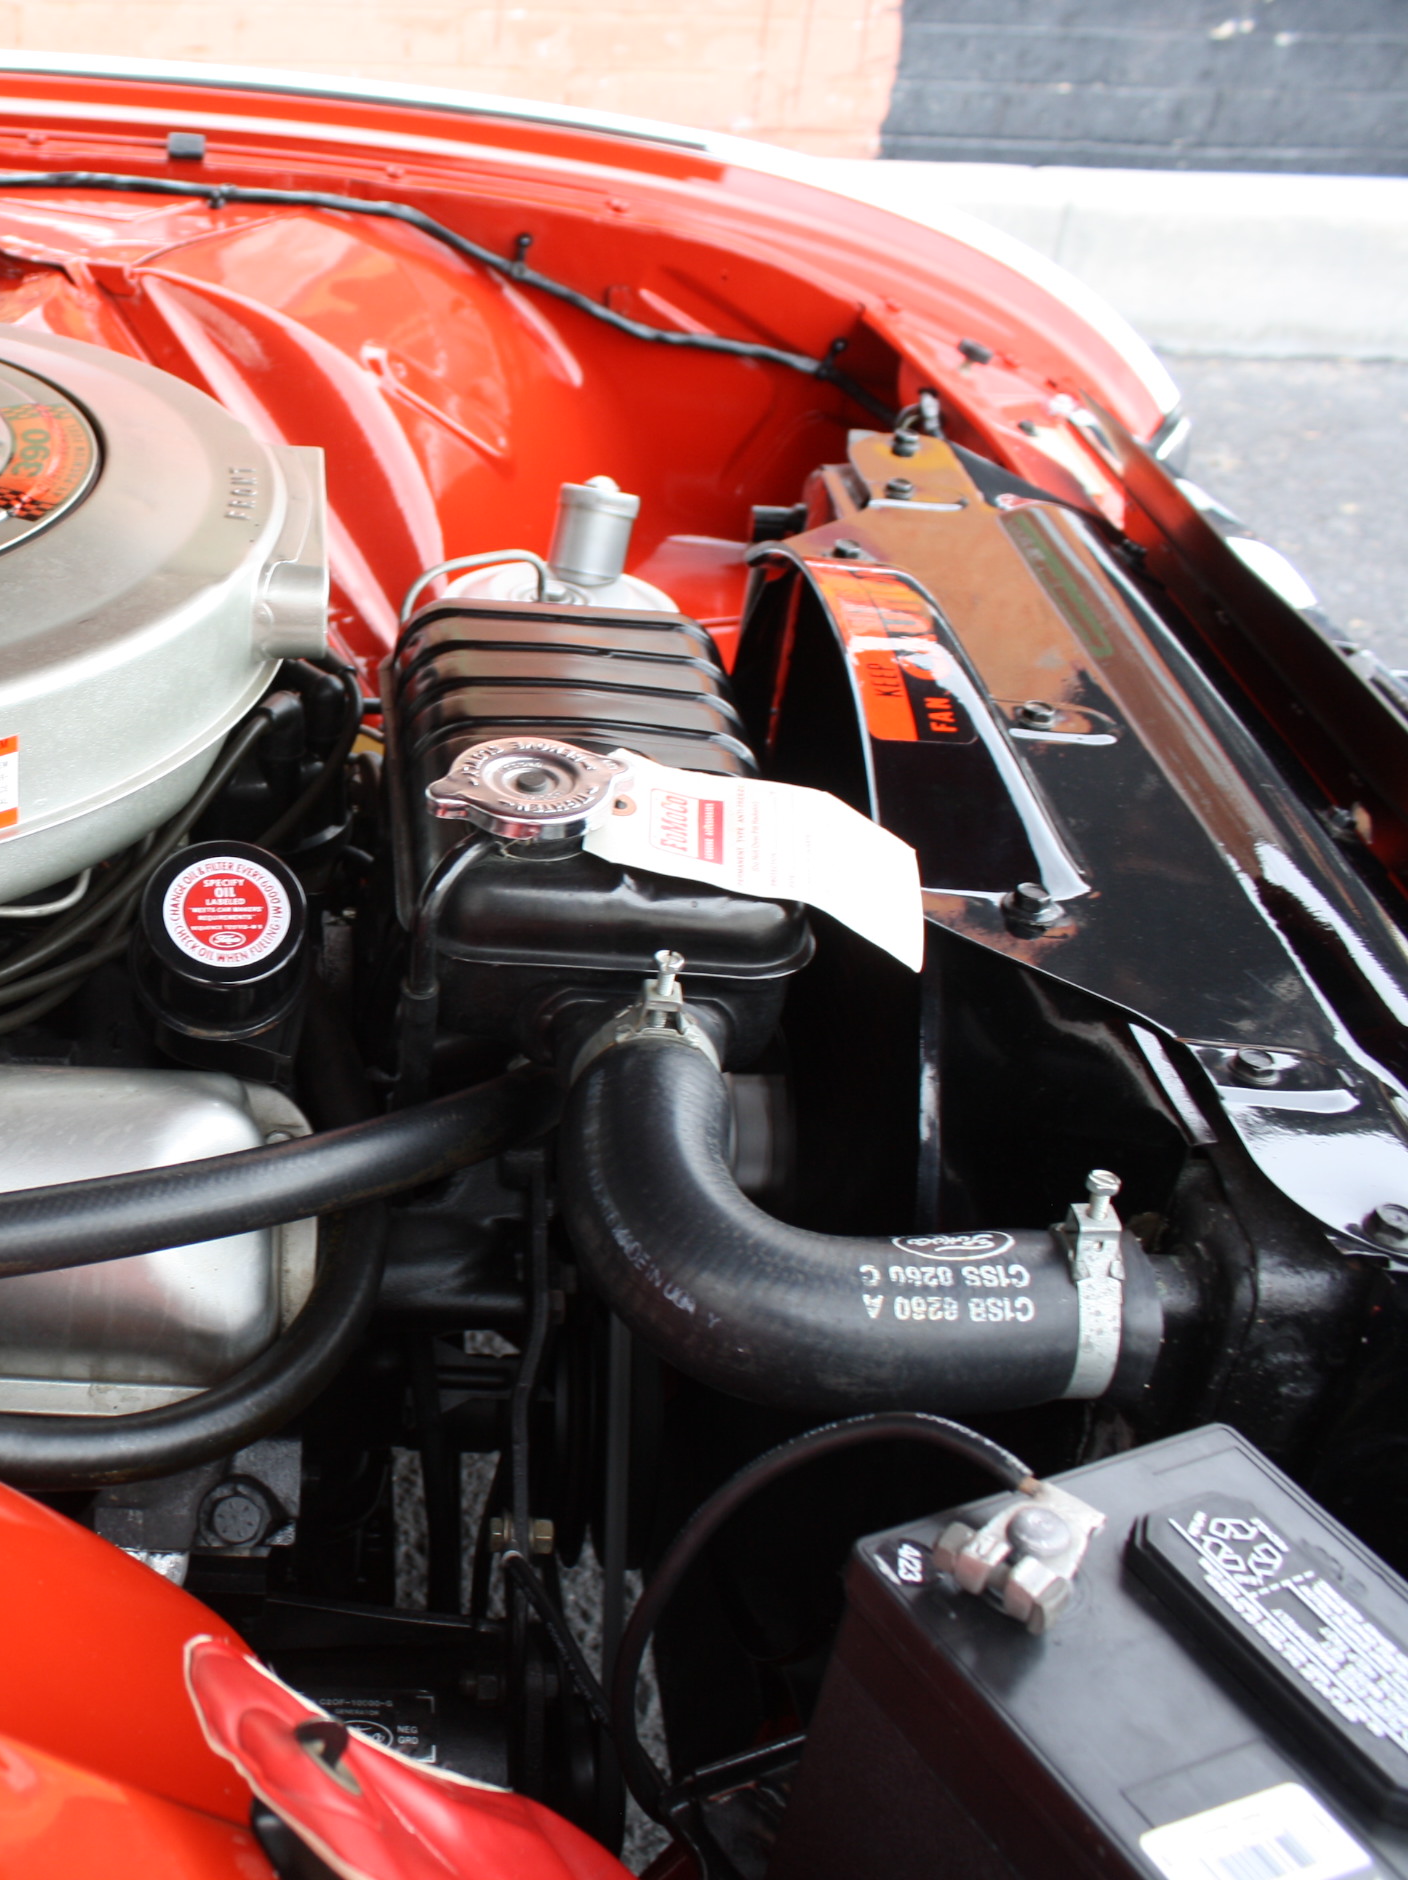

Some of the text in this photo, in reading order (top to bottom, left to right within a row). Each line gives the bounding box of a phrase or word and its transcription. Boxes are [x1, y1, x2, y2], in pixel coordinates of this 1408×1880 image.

[12, 428, 51, 477] 390
[224, 466, 258, 520] FRONT
[867, 663, 904, 698] KEEP
[923, 697, 959, 733] FAN
[659, 795, 689, 852] FoMoCo
[736, 827, 745, 843] TYPE
[169, 884, 187, 922] CHANGE
[182, 870, 199, 885] OIL
[205, 861, 235, 873] FILTER
[236, 863, 263, 882] EVERY
[202, 878, 246, 888] SPECIFY
[213, 887, 237, 898] OIL
[204, 897, 247, 906] LABELED
[174, 923, 282, 963] CHECK OIL WHEN FUELING
[859, 1264, 882, 1287] C
[961, 1264, 1032, 1288] C1SS
[862, 1294, 884, 1319] A
[396, 1725, 418, 1734] NEG
[397, 1736, 419, 1745] GRD
